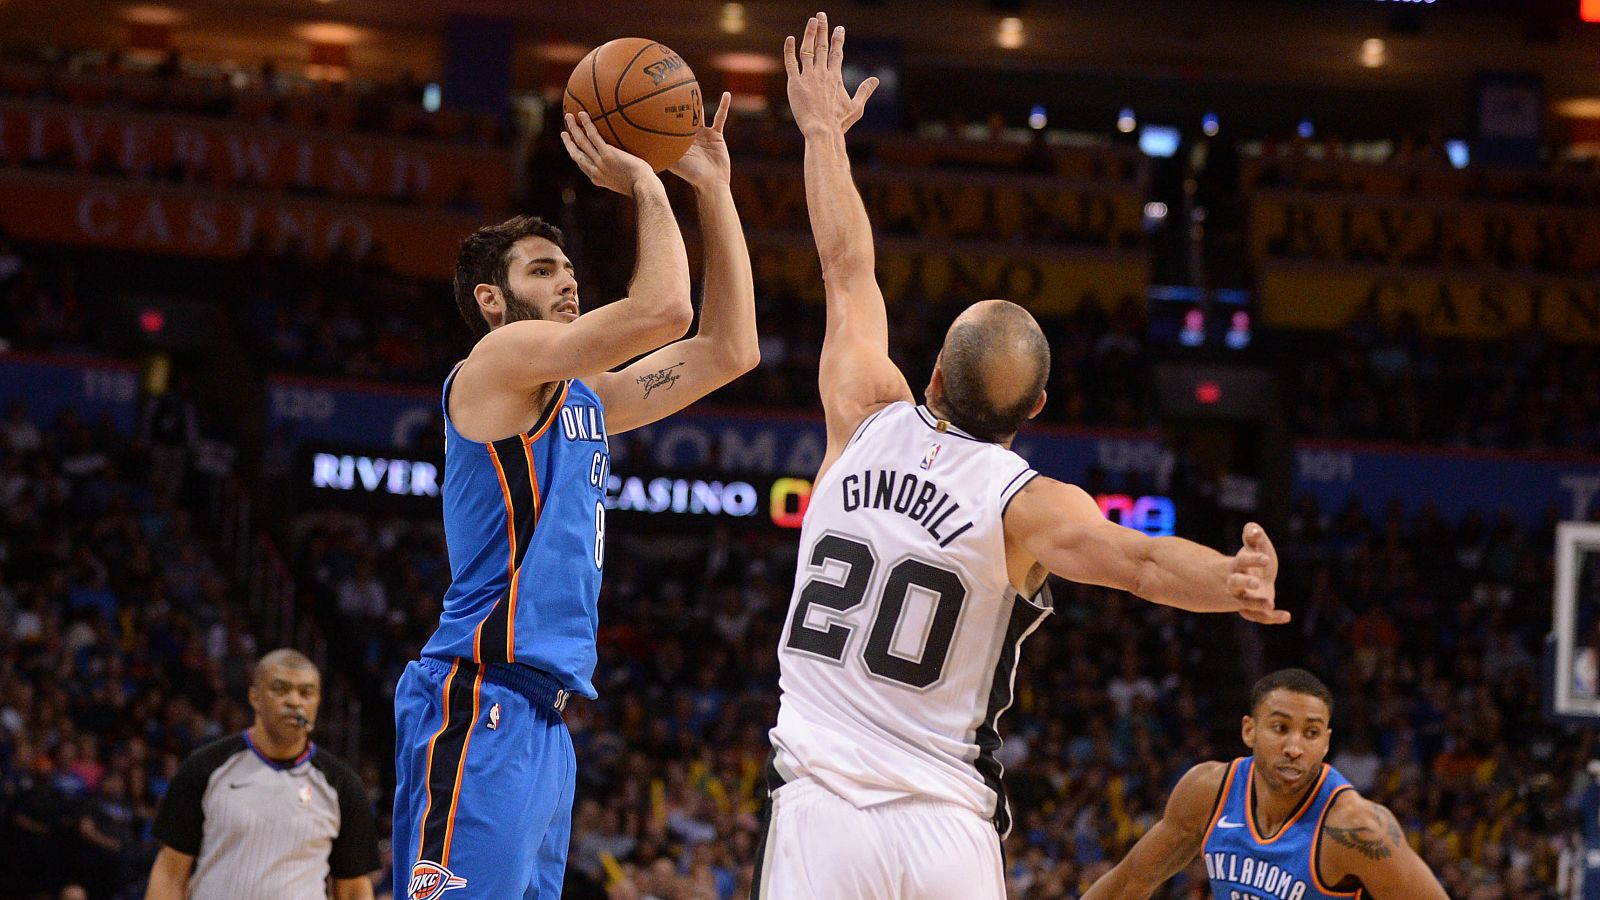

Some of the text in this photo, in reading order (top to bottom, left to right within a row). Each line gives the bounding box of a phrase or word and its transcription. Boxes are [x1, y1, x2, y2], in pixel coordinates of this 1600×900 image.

[0, 113, 433, 196] IVERWIND
[76, 191, 373, 259] CASINO
[643, 370, 680, 400] Goodbye
[561, 405, 606, 445] OKL
[594, 499, 606, 572] 8
[842, 470, 974, 548] GINOBILI
[783, 528, 971, 693] 20
[409, 873, 440, 898] OKC
